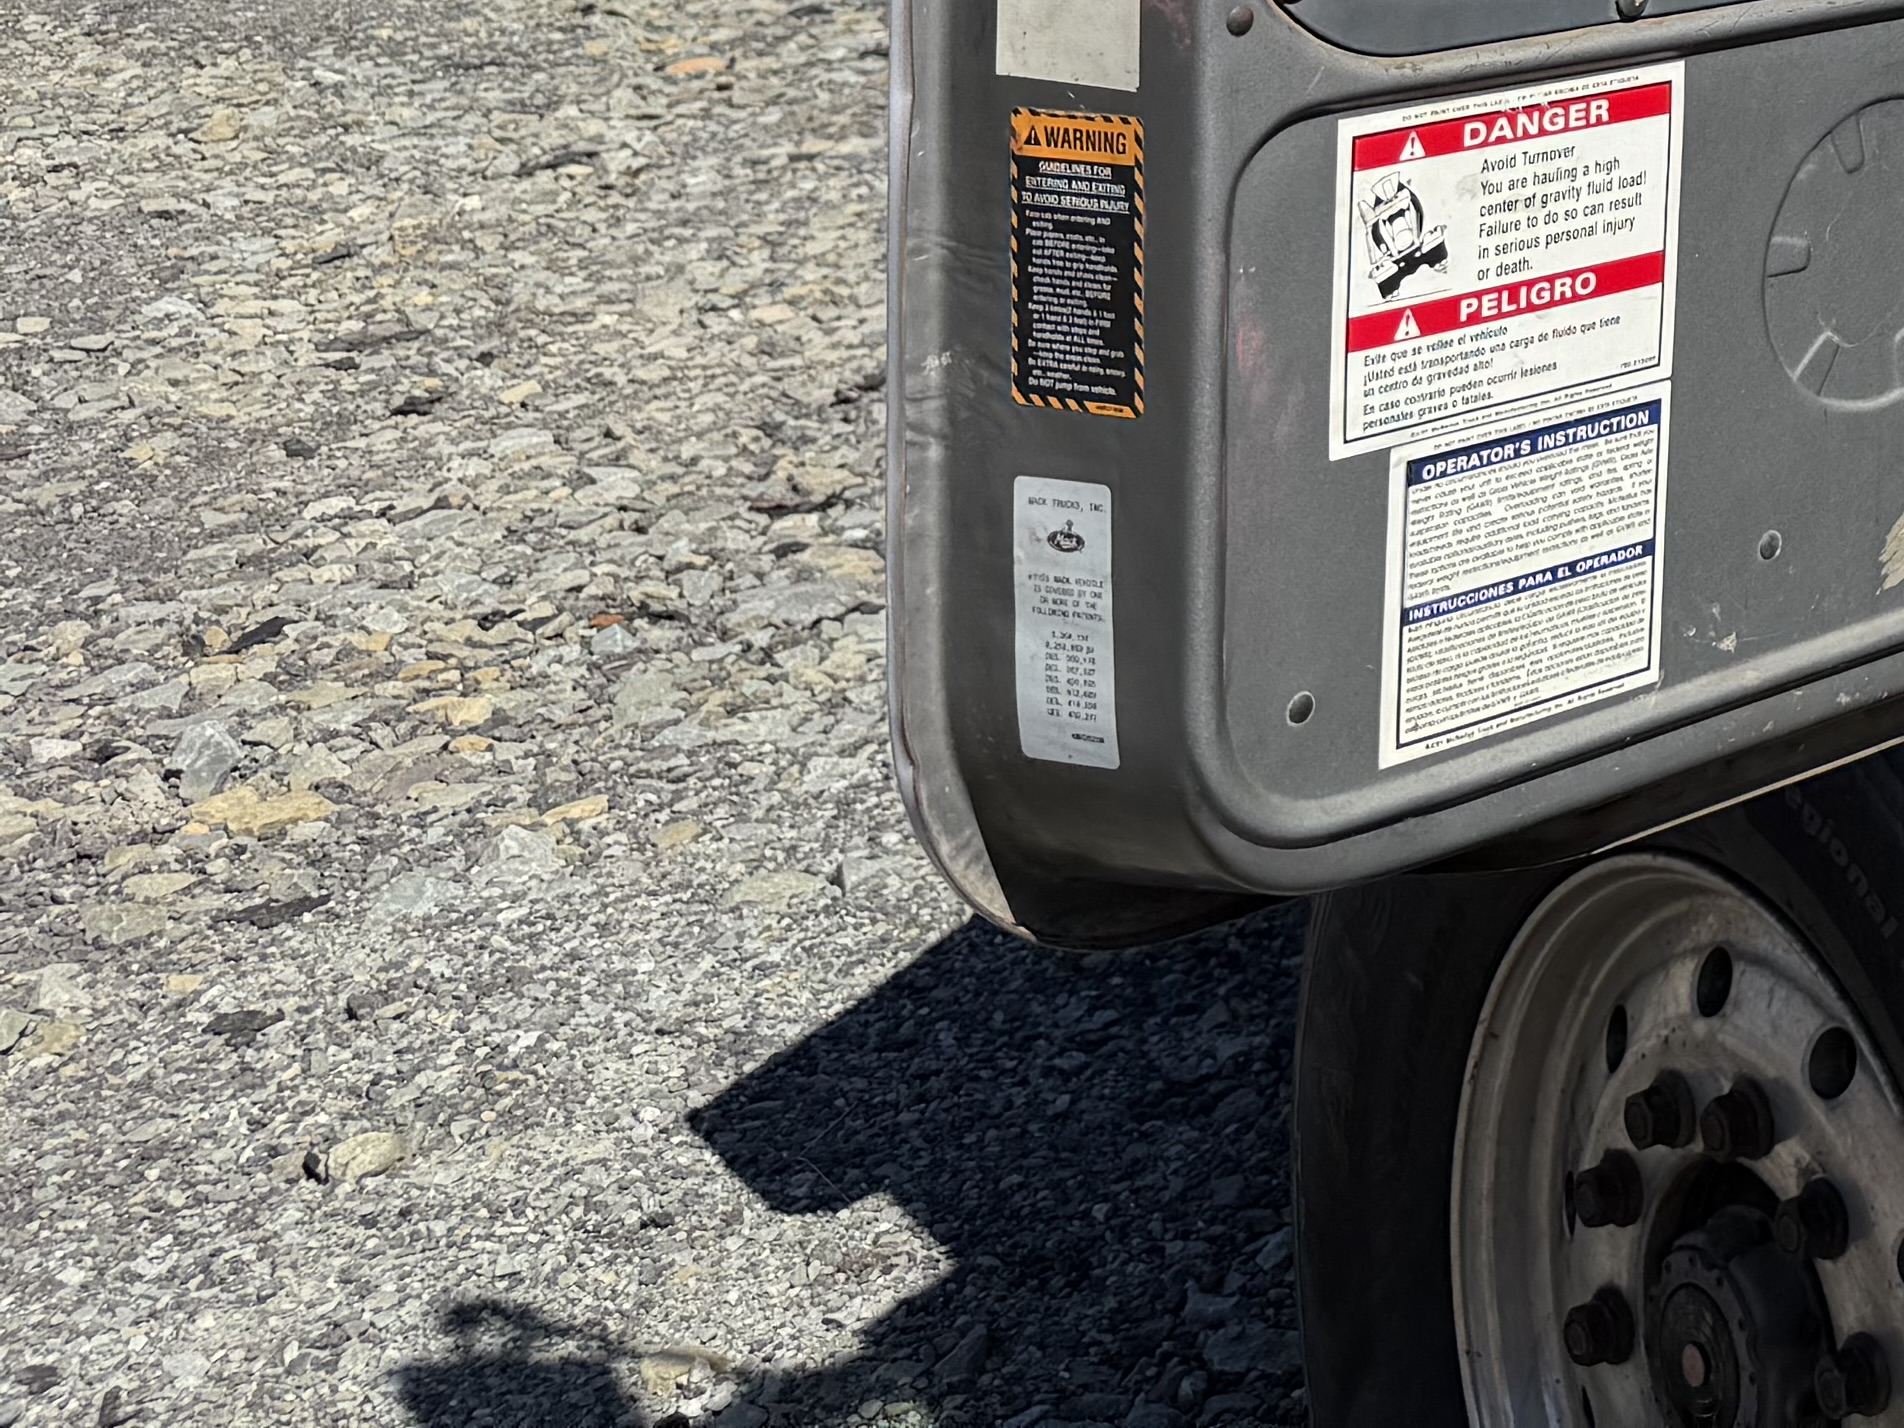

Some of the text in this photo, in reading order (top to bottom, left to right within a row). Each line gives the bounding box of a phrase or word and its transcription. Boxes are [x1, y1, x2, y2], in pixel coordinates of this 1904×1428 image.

[1044, 124, 1126, 156] WARNING
[1462, 98, 1610, 148] DANGER
[1038, 159, 1111, 177] GUIDELINES FOR
[1480, 142, 1575, 174] Avoid Turnover
[1480, 155, 1620, 196] You are hauling a high
[1021, 191, 1129, 211] TO AVOID SERIOUS INJURY
[1025, 174, 1125, 195] ENTERING AND EXITING
[1479, 170, 1646, 217] center of gravity fluid load!
[1478, 191, 1642, 239] Failure to do so can result
[1478, 213, 1635, 260] in serious personal injury
[1477, 255, 1533, 281] or death.
[1459, 270, 1597, 323] PELIGRO
[1389, 347, 1407, 362] que
[1411, 345, 1423, 356] se
[1457, 332, 1466, 345] el
[1489, 342, 1506, 354] una
[1509, 334, 1534, 352] carga
[1537, 330, 1549, 343] de
[1551, 323, 1577, 339] fluido
[1579, 321, 1596, 335] que
[1362, 402, 1374, 416] En
[1378, 398, 1400, 412] caso
[1449, 377, 1483, 397] pueden
[1486, 368, 1516, 386] ocurrir
[1520, 358, 1557, 378] lesiones
[1363, 387, 1374, 398] un
[1378, 377, 1408, 394] centro
[1411, 373, 1423, 386] de
[1426, 363, 1469, 385] gravedad
[1362, 408, 1413, 432] personales
[1417, 401, 1448, 419] graves
[1451, 399, 1457, 408] o
[1421, 408, 1649, 481] OPERATOR'S INSTRUCTION
[1408, 543, 1643, 622] INSTRUCCIONES PARA EL OPERADOR
[1785, 787, 1899, 940] egional
